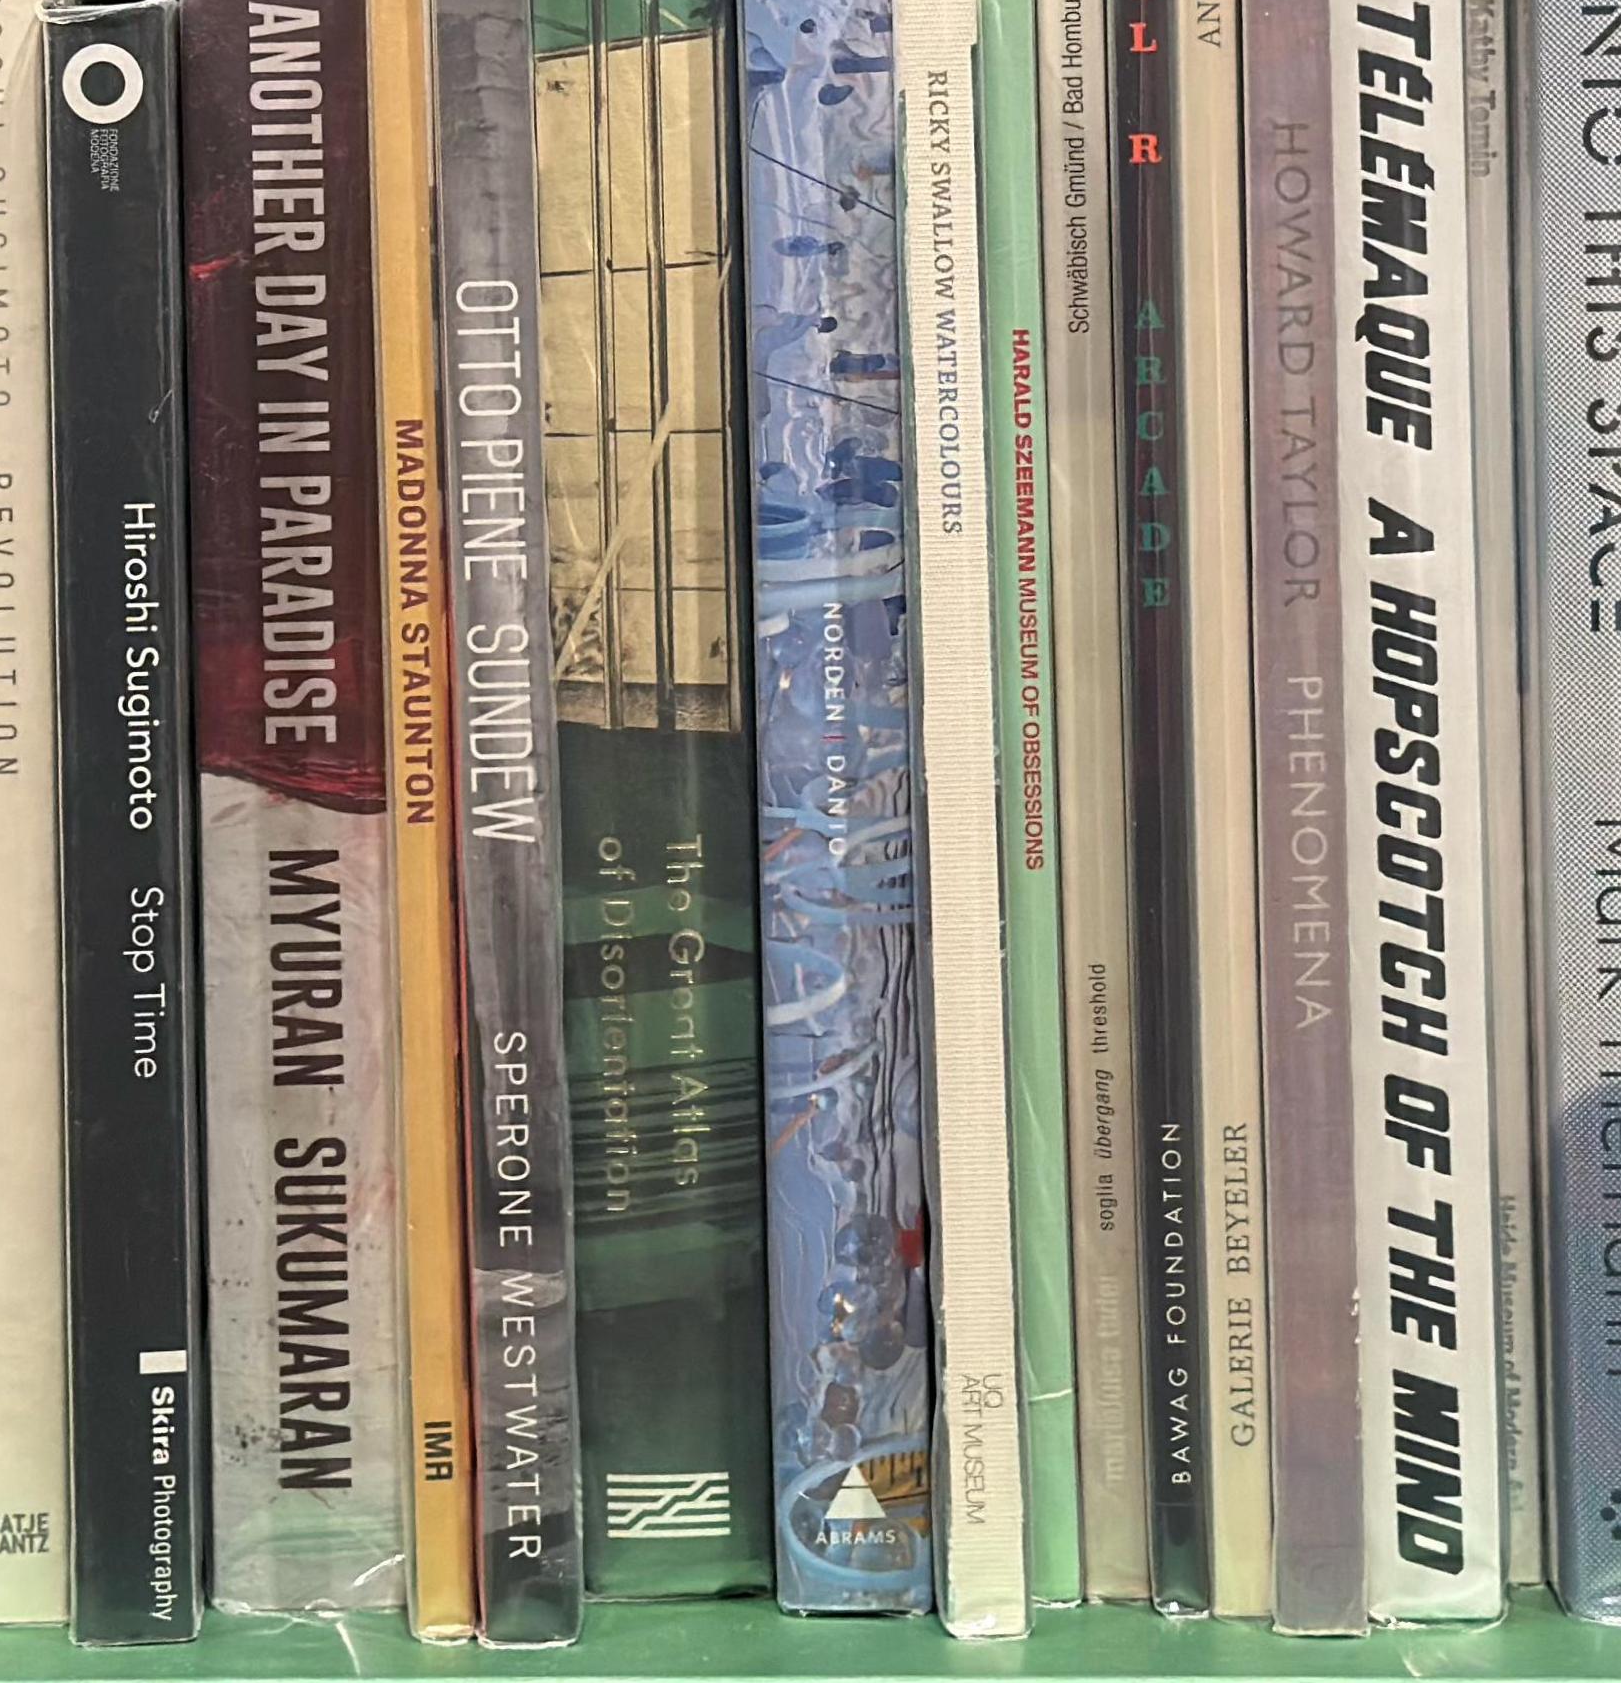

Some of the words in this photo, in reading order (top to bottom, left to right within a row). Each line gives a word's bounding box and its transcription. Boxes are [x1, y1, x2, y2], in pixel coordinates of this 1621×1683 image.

[245, 0, 326, 257] ANOTHER
[926, 71, 950, 155] RICKY
[1062, 76, 1084, 114] Bad
[928, 162, 955, 301] SWALLOW
[1063, 137, 1086, 208] Gmünd
[1350, 1, 1435, 451] TÉLÉMAQUE
[1064, 216, 1089, 334] Schwäbisch
[1268, 121, 1314, 375] HOWARD
[453, 279, 523, 418] OTTO
[1009, 328, 1032, 427] HARALD
[932, 310, 961, 536] WATERCOLOURS
[118, 501, 157, 634] Hiroshi
[393, 419, 429, 613] MADONNA
[460, 438, 529, 583] PIENE
[1013, 433, 1036, 572] SZEEMANN
[1279, 394, 1320, 608] TAYLOR
[258, 474, 337, 746] PARADISE
[820, 601, 845, 722] NORDEN
[1017, 577, 1040, 679] MUSEUM
[117, 647, 159, 830] Sugimoto
[398, 622, 434, 826] STAUNTON
[466, 623, 536, 844] SUNDEW
[1021, 686, 1041, 718] OF
[826, 754, 848, 857] DANTO
[1021, 721, 1045, 871] OBSESSIONS
[1284, 675, 1330, 1028] PHENOMENA
[1369, 580, 1448, 1057] HOPSCOTCH
[122, 886, 163, 974] Stop
[664, 833, 703, 912] The
[131, 984, 167, 1079] Time
[266, 849, 344, 1088] MYURAN
[666, 931, 708, 1061] Great
[1086, 963, 1109, 1054] threshold
[597, 897, 637, 1213] Disorientation
[1091, 1068, 1114, 1160] übergang
[494, 1031, 531, 1247] SPERONE
[669, 1074, 711, 1186] Atlas
[1222, 1122, 1252, 1274] BEYELER
[1098, 1173, 1118, 1231] soglia
[1160, 1122, 1187, 1344] FOUNDATION
[271, 1136, 353, 1493] SUKUMARAN
[1228, 1297, 1256, 1448] GALERIE
[150, 1387, 176, 1466] Skira
[500, 1273, 540, 1560] WESTWATER
[1167, 1367, 1192, 1484] BAWAG
[1388, 1369, 1464, 1577] MIND
[147, 1474, 177, 1623] Photography
[815, 1530, 896, 1545] ABRAMS
